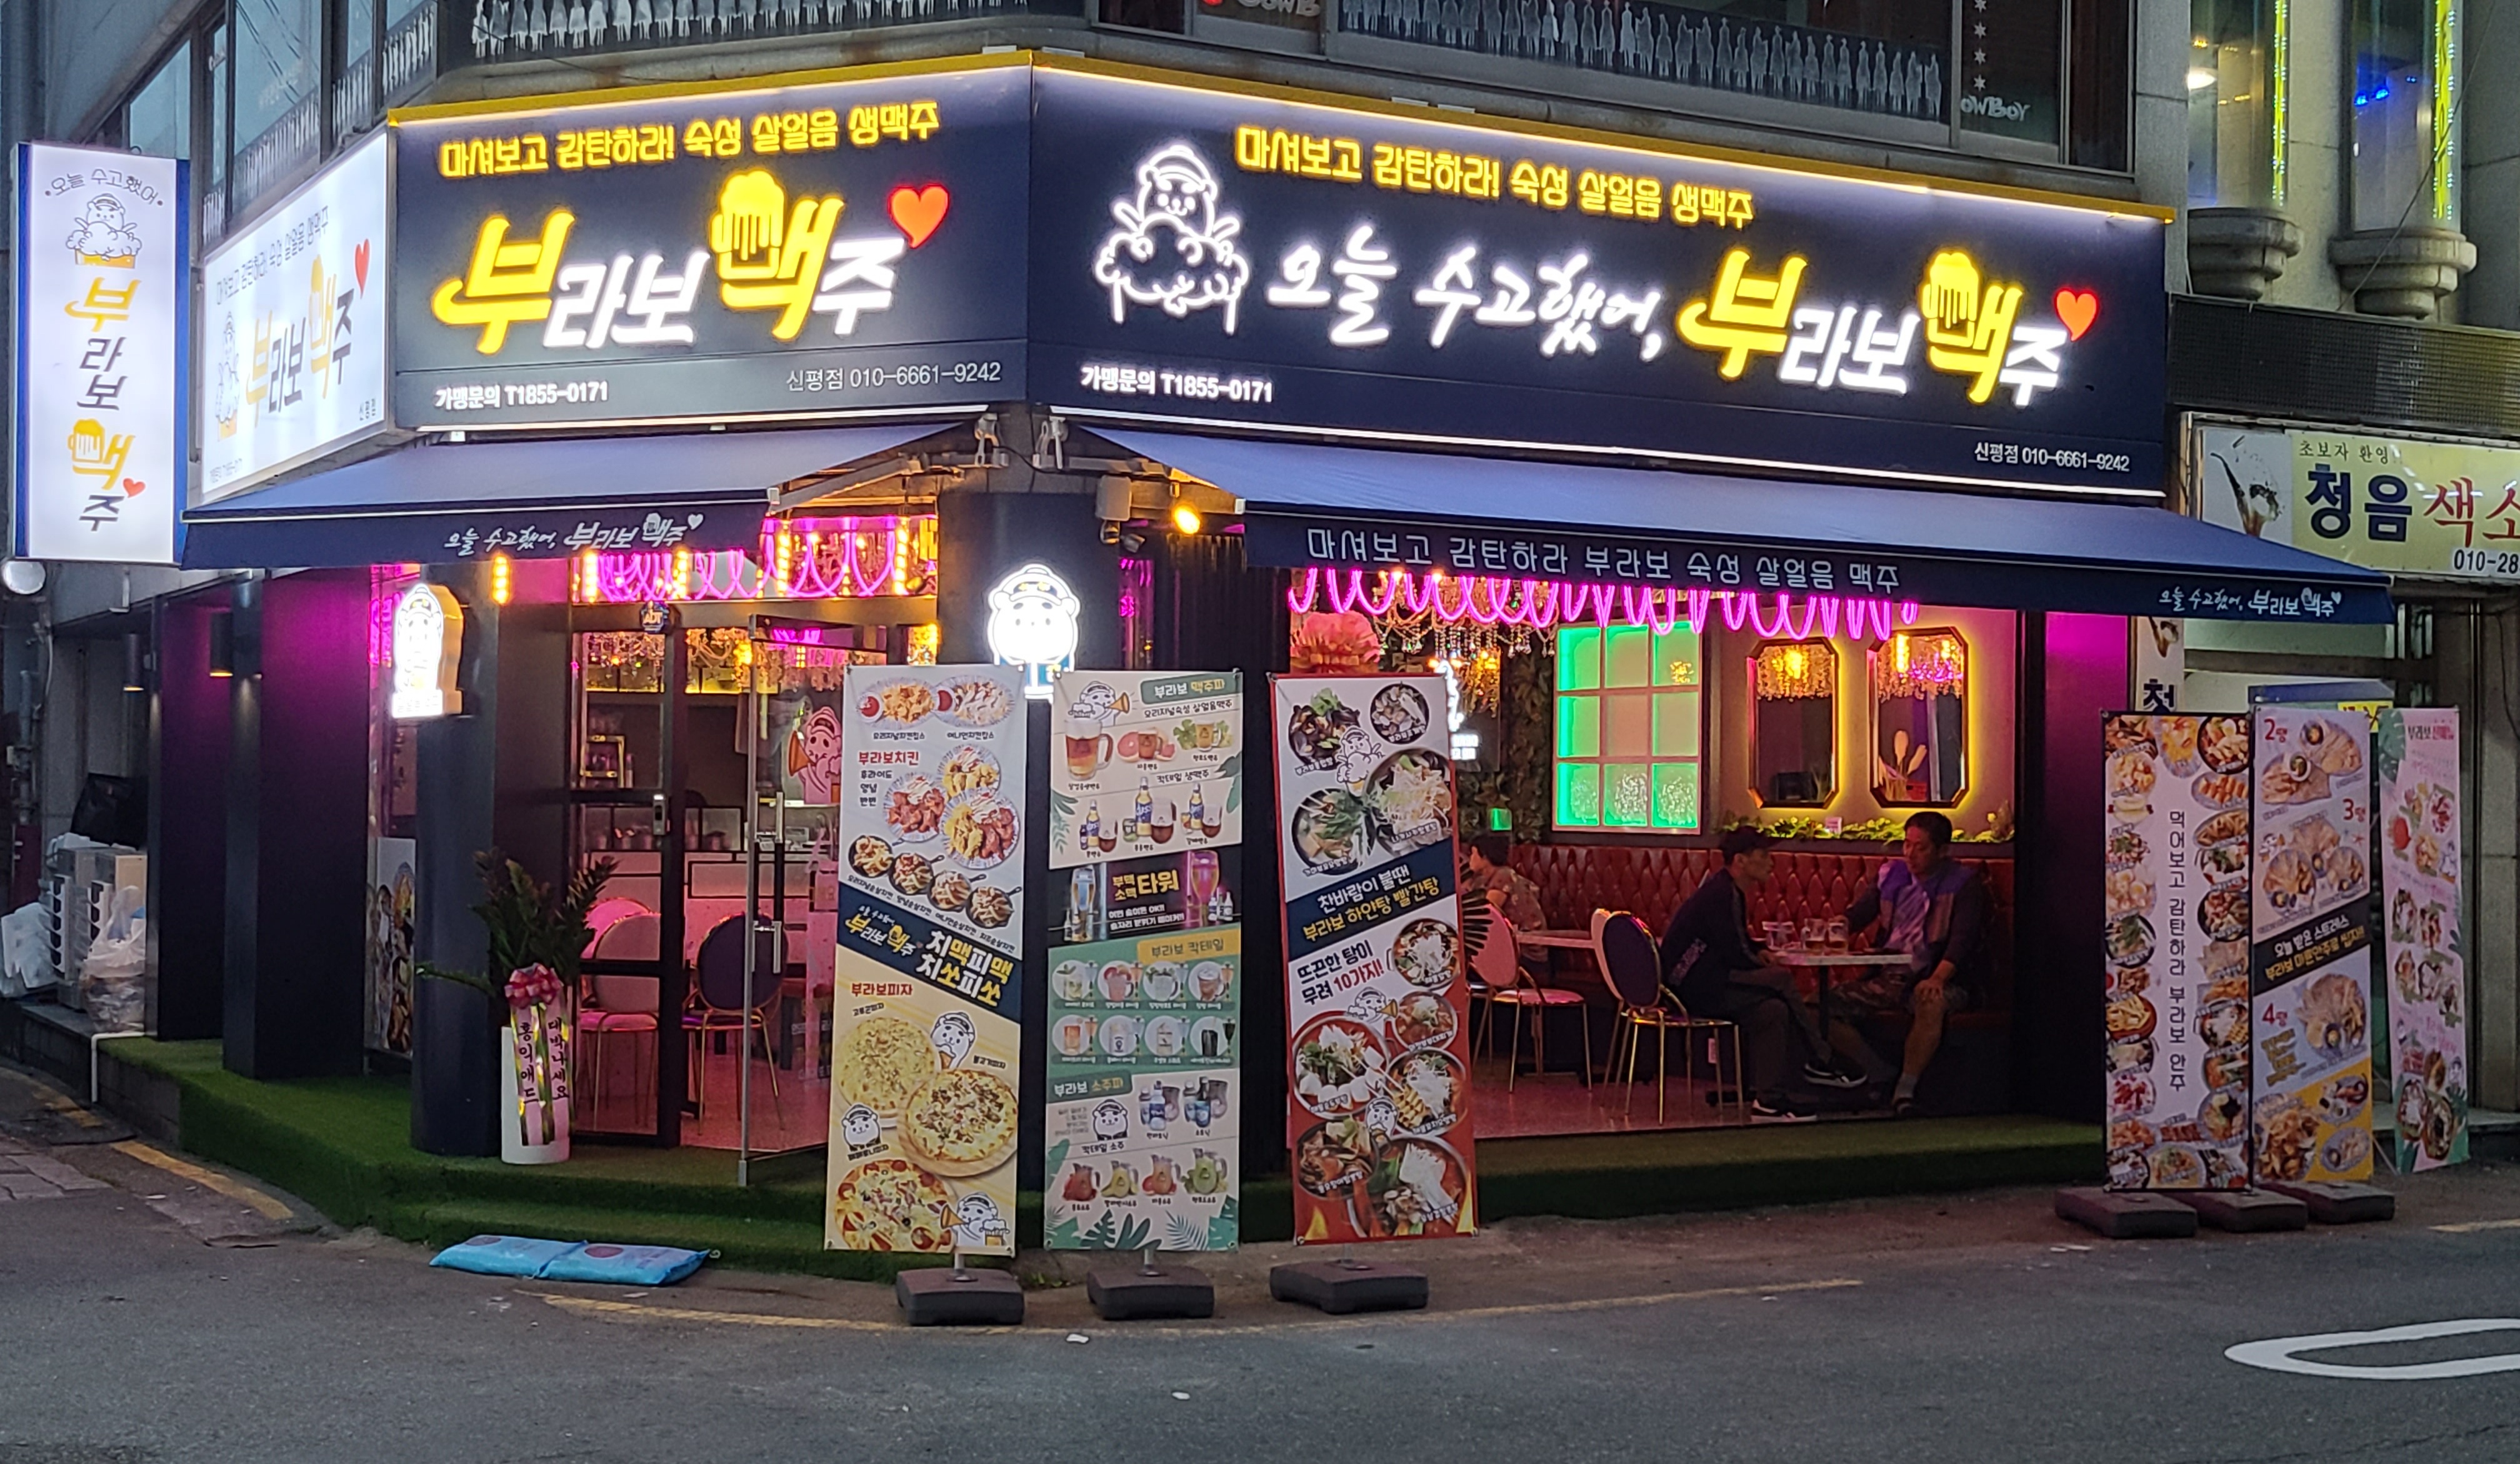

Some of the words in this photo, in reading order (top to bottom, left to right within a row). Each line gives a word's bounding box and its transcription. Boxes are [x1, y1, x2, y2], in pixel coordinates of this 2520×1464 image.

[439, 134, 549, 178] 마셔보고
[556, 124, 675, 168] 감탄하라!
[684, 118, 742, 159] 숙성
[751, 109, 839, 154] 살얼음
[849, 100, 940, 146] 생맥주
[51, 173, 84, 196] 오늘
[91, 168, 159, 204] 수고했어
[1235, 126, 1363, 181] 마셔보고
[1372, 143, 1501, 199] 감탄하라!
[1510, 159, 1569, 208] 숙성
[1578, 169, 1663, 219] 살얼음
[1671, 180, 1754, 229] 생맥주
[1266, 224, 1398, 348] 오늘
[786, 367, 843, 394] 신평점
[849, 361, 1001, 389] 010-6661-9242
[1081, 365, 1156, 396] 가맹문의
[1161, 373, 1274, 404] T1855-0171
[434, 383, 500, 411] 가맹문의
[505, 380, 609, 408] T1855-0171
[1974, 440, 2019, 466] 신평점
[2021, 444, 2130, 473] 010-6661-9242
[2299, 440, 2349, 461] 초보자
[444, 528, 479, 556] 오늘
[1306, 528, 1432, 566] 마셔보고
[1448, 538, 1569, 575] 감탄하라
[1584, 545, 1673, 579] 부라보
[1686, 552, 1741, 586] 숙성
[1754, 555, 1836, 589] 살얼음
[1848, 563, 1901, 594] 맥주
[2454, 549, 2520, 574] 010-28
[2159, 586, 2184, 613] 오늘
[642, 610, 663, 624] ADT
[1154, 683, 1188, 699] 부라보
[859, 751, 919, 766] 부라보치킨
[860, 783, 878, 794] 양념
[861, 770, 892, 780] 후라이드
[1157, 772, 1182, 783] 칵테일
[1185, 770, 1210, 781] 생맥주
[859, 797, 876, 806] 반반
[2169, 811, 2185, 888] 먹어보고
[1137, 869, 1179, 895] 타워
[1317, 878, 1379, 914] 찬바람이
[1380, 865, 1411, 895] 불땐
[1302, 914, 1346, 941] 부라보
[1345, 895, 1391, 923] 하얀탕
[1393, 876, 1440, 908] 빨간탕
[1152, 943, 1184, 958] 부라보
[1188, 939, 1224, 954] 칵테일
[2169, 898, 2186, 976] 감탄하라
[2274, 940, 2294, 958] 오늘
[2314, 915, 2350, 940] 스트레스
[926, 930, 1014, 985] 치맥피맥
[1297, 953, 1342, 985] 뜨끈한
[1343, 940, 1373, 965] 탕이
[2265, 957, 2294, 981] 부라보
[851, 983, 912, 997] 부라보피자
[916, 953, 1001, 1007] 치쏘피쏘
[1301, 979, 1334, 1005] 무려
[2169, 986, 2186, 1043] 부라보
[548, 1016, 570, 1100] 대박나세요
[2169, 1054, 2186, 1092] 안주
[1054, 1081, 1088, 1098] 부라보
[1111, 1141, 1124, 1151] 소주
